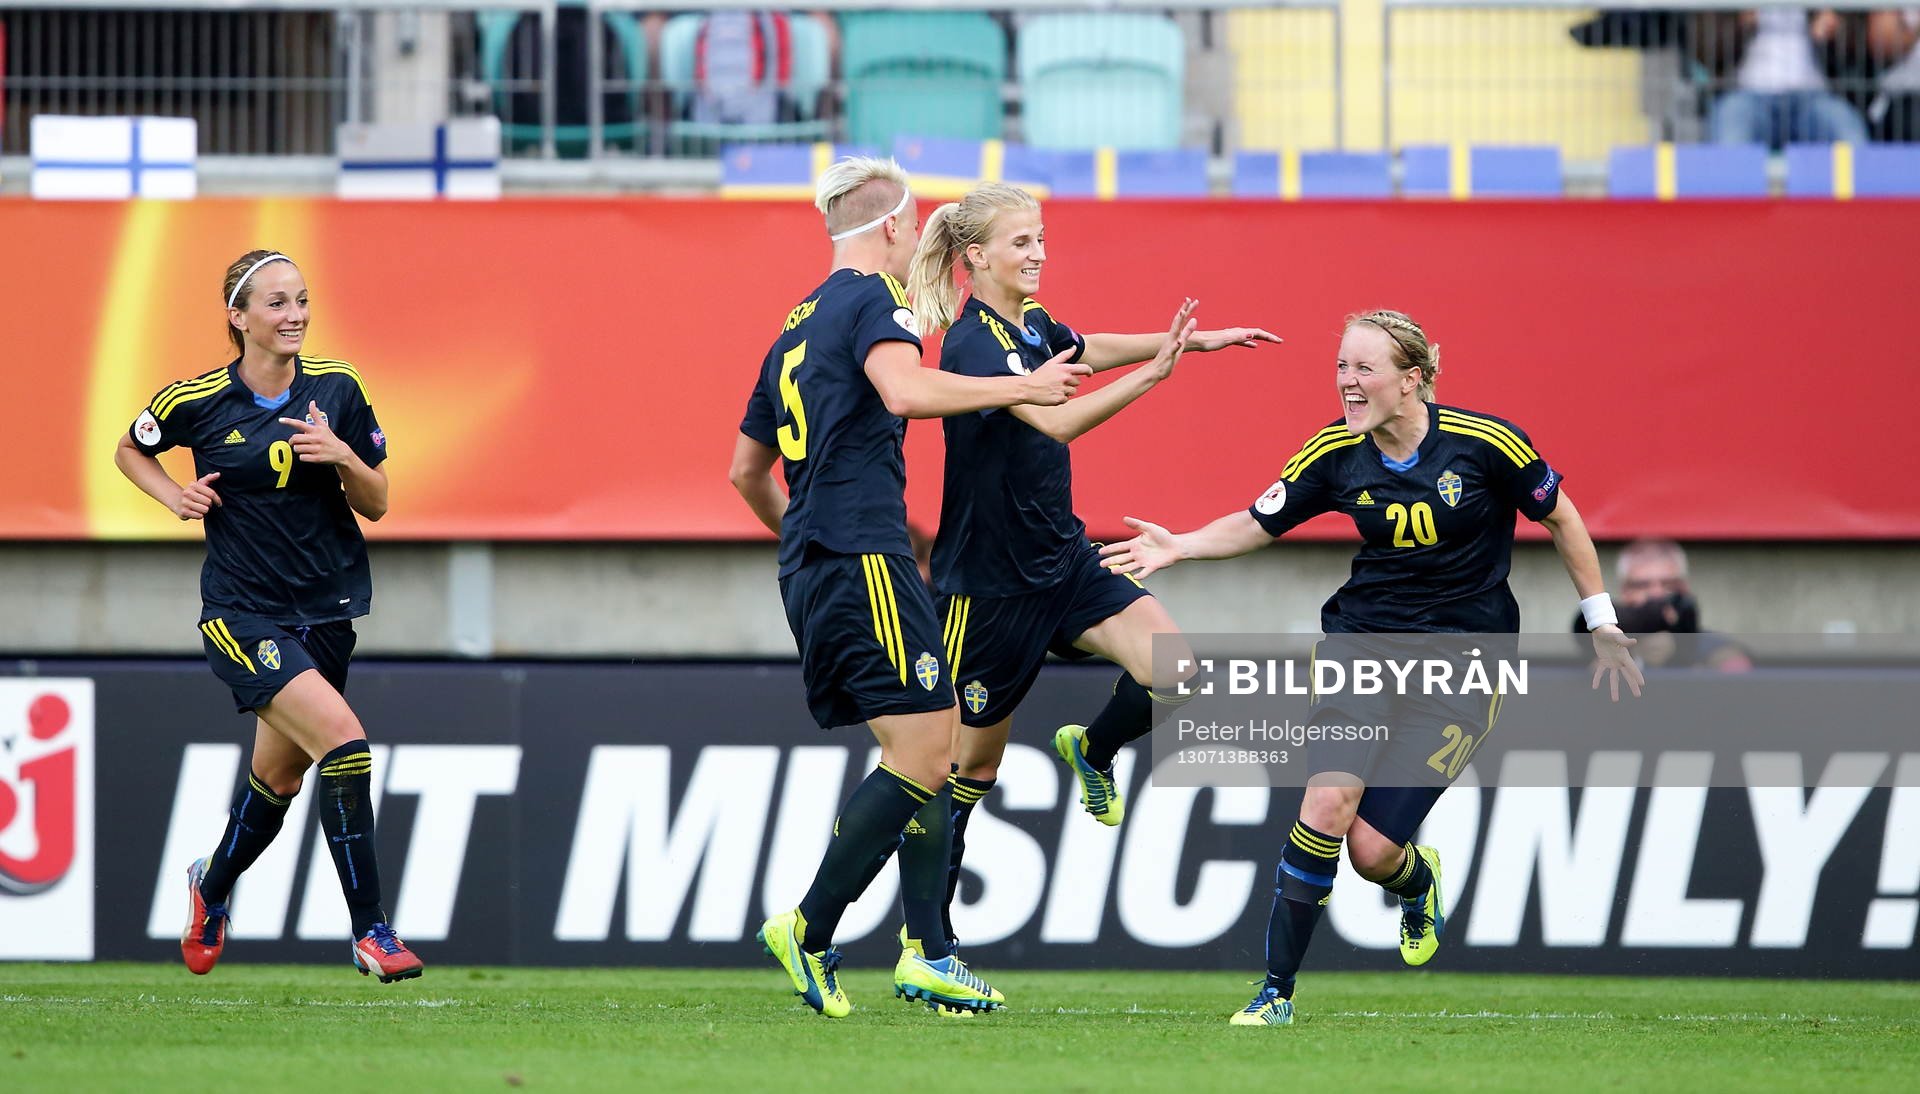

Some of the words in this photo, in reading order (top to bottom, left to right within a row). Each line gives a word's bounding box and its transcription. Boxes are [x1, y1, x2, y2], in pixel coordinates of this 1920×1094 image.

[777, 339, 807, 461] 5
[268, 440, 293, 489] 9
[1385, 501, 1438, 548] 20
[1426, 724, 1474, 779] 20
